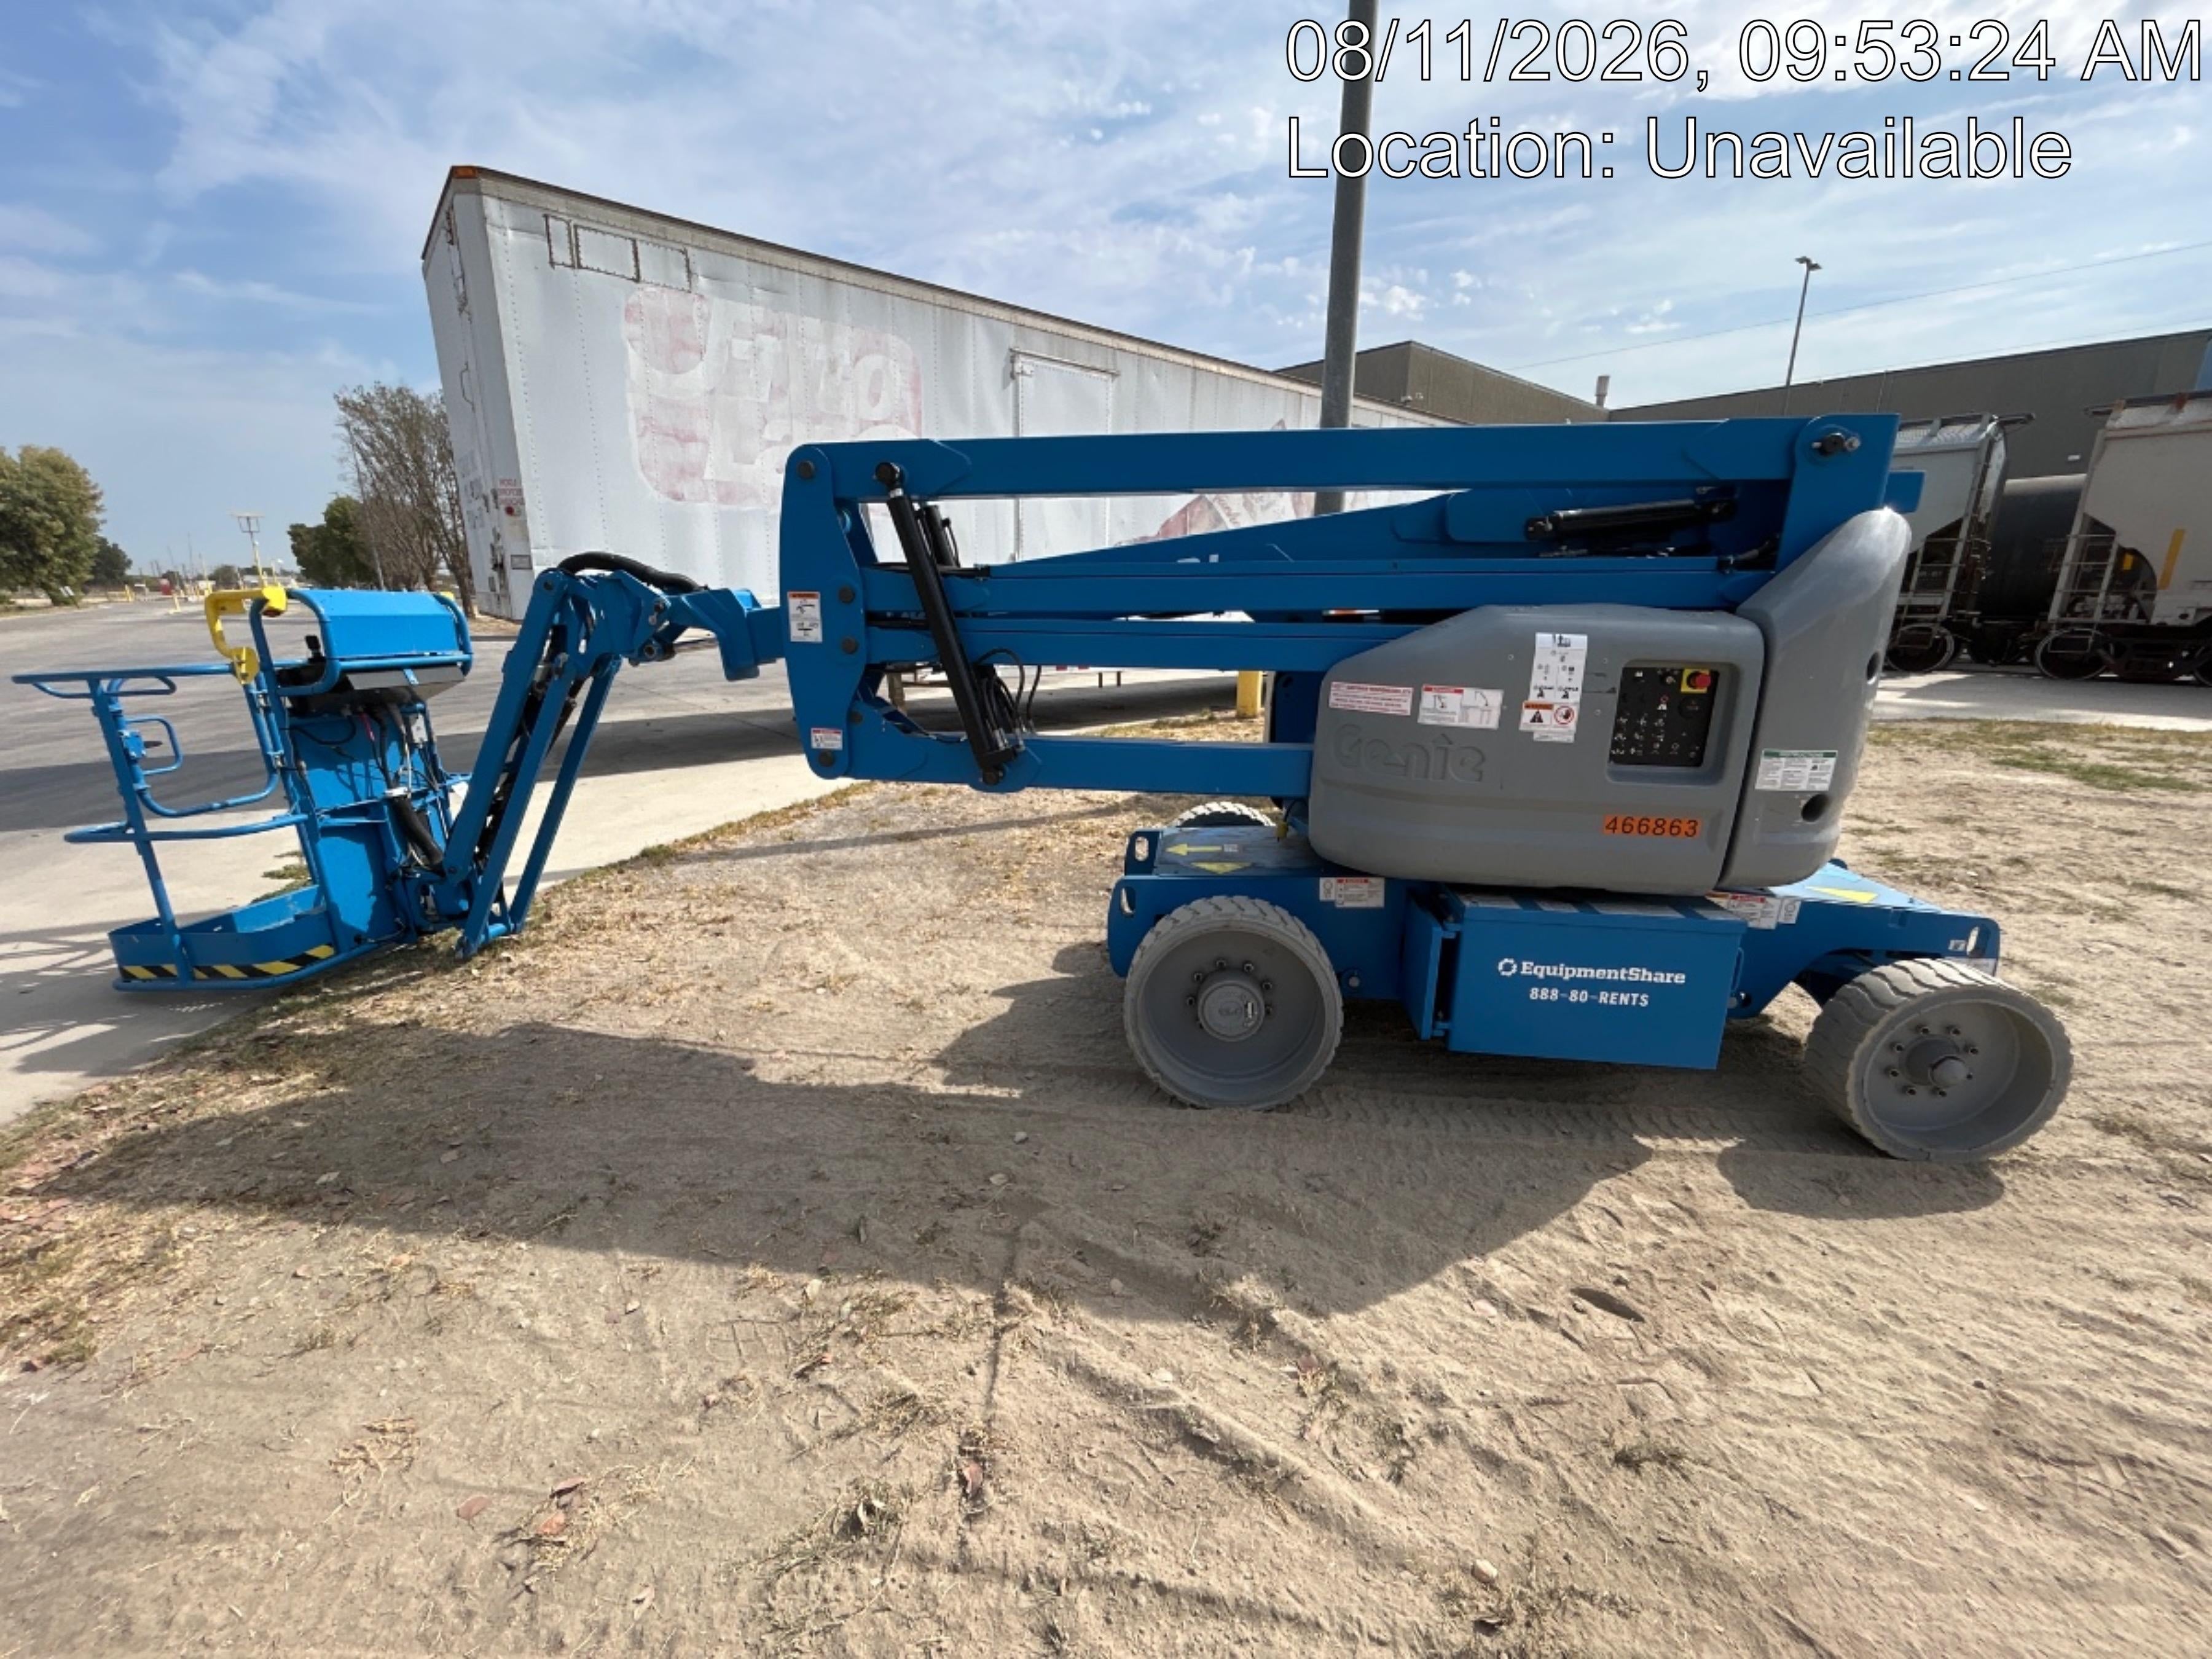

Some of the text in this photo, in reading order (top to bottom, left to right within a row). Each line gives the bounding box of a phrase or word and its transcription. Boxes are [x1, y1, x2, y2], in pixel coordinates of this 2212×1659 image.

[1332, 724, 1485, 782] Genie
[1605, 815, 1698, 837] 466863
[1520, 962, 1686, 984] EquipmentShare
